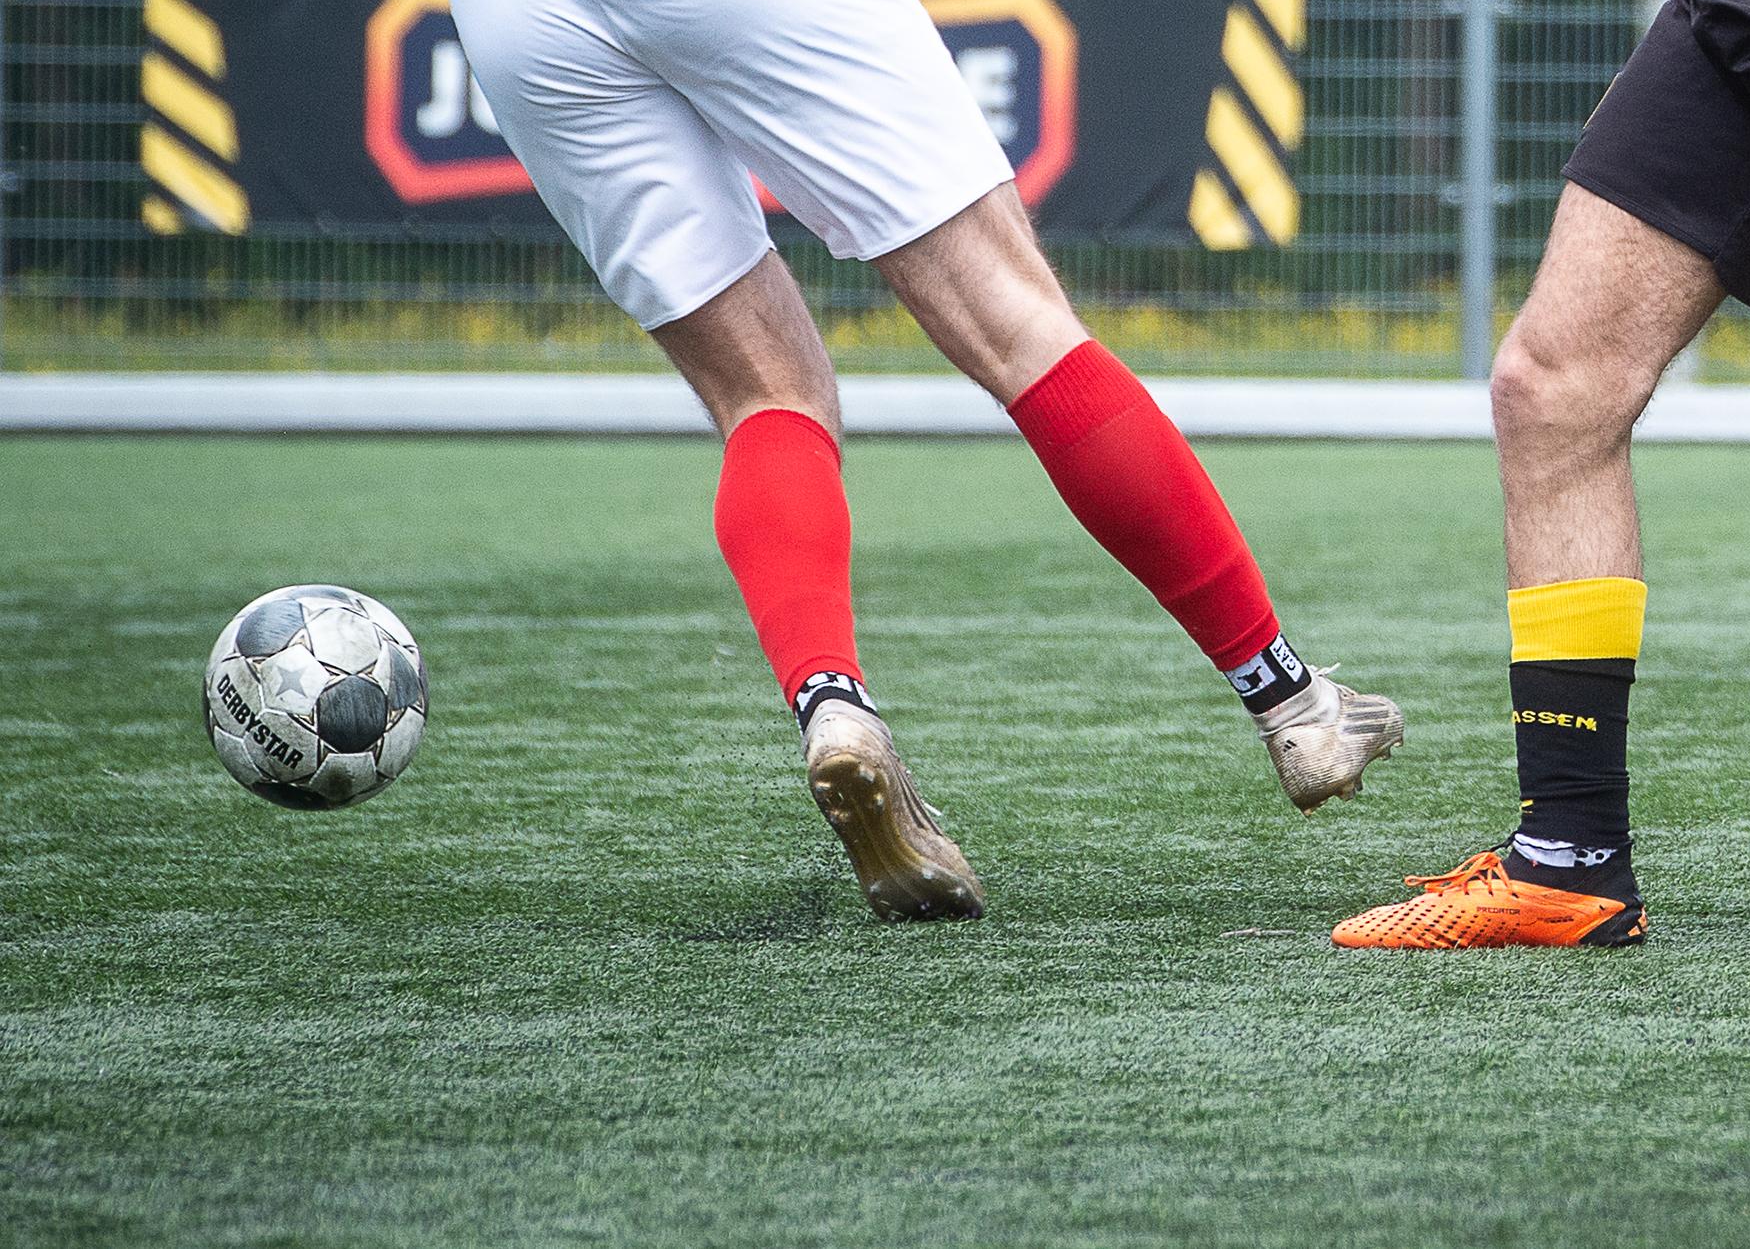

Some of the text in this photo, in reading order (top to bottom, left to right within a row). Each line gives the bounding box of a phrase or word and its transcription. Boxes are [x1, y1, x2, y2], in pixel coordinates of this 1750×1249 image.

[217, 673, 305, 780] DERBYSTAR
[1511, 709, 1597, 732] ASSEN
[1476, 905, 1521, 916] PREDATOR
